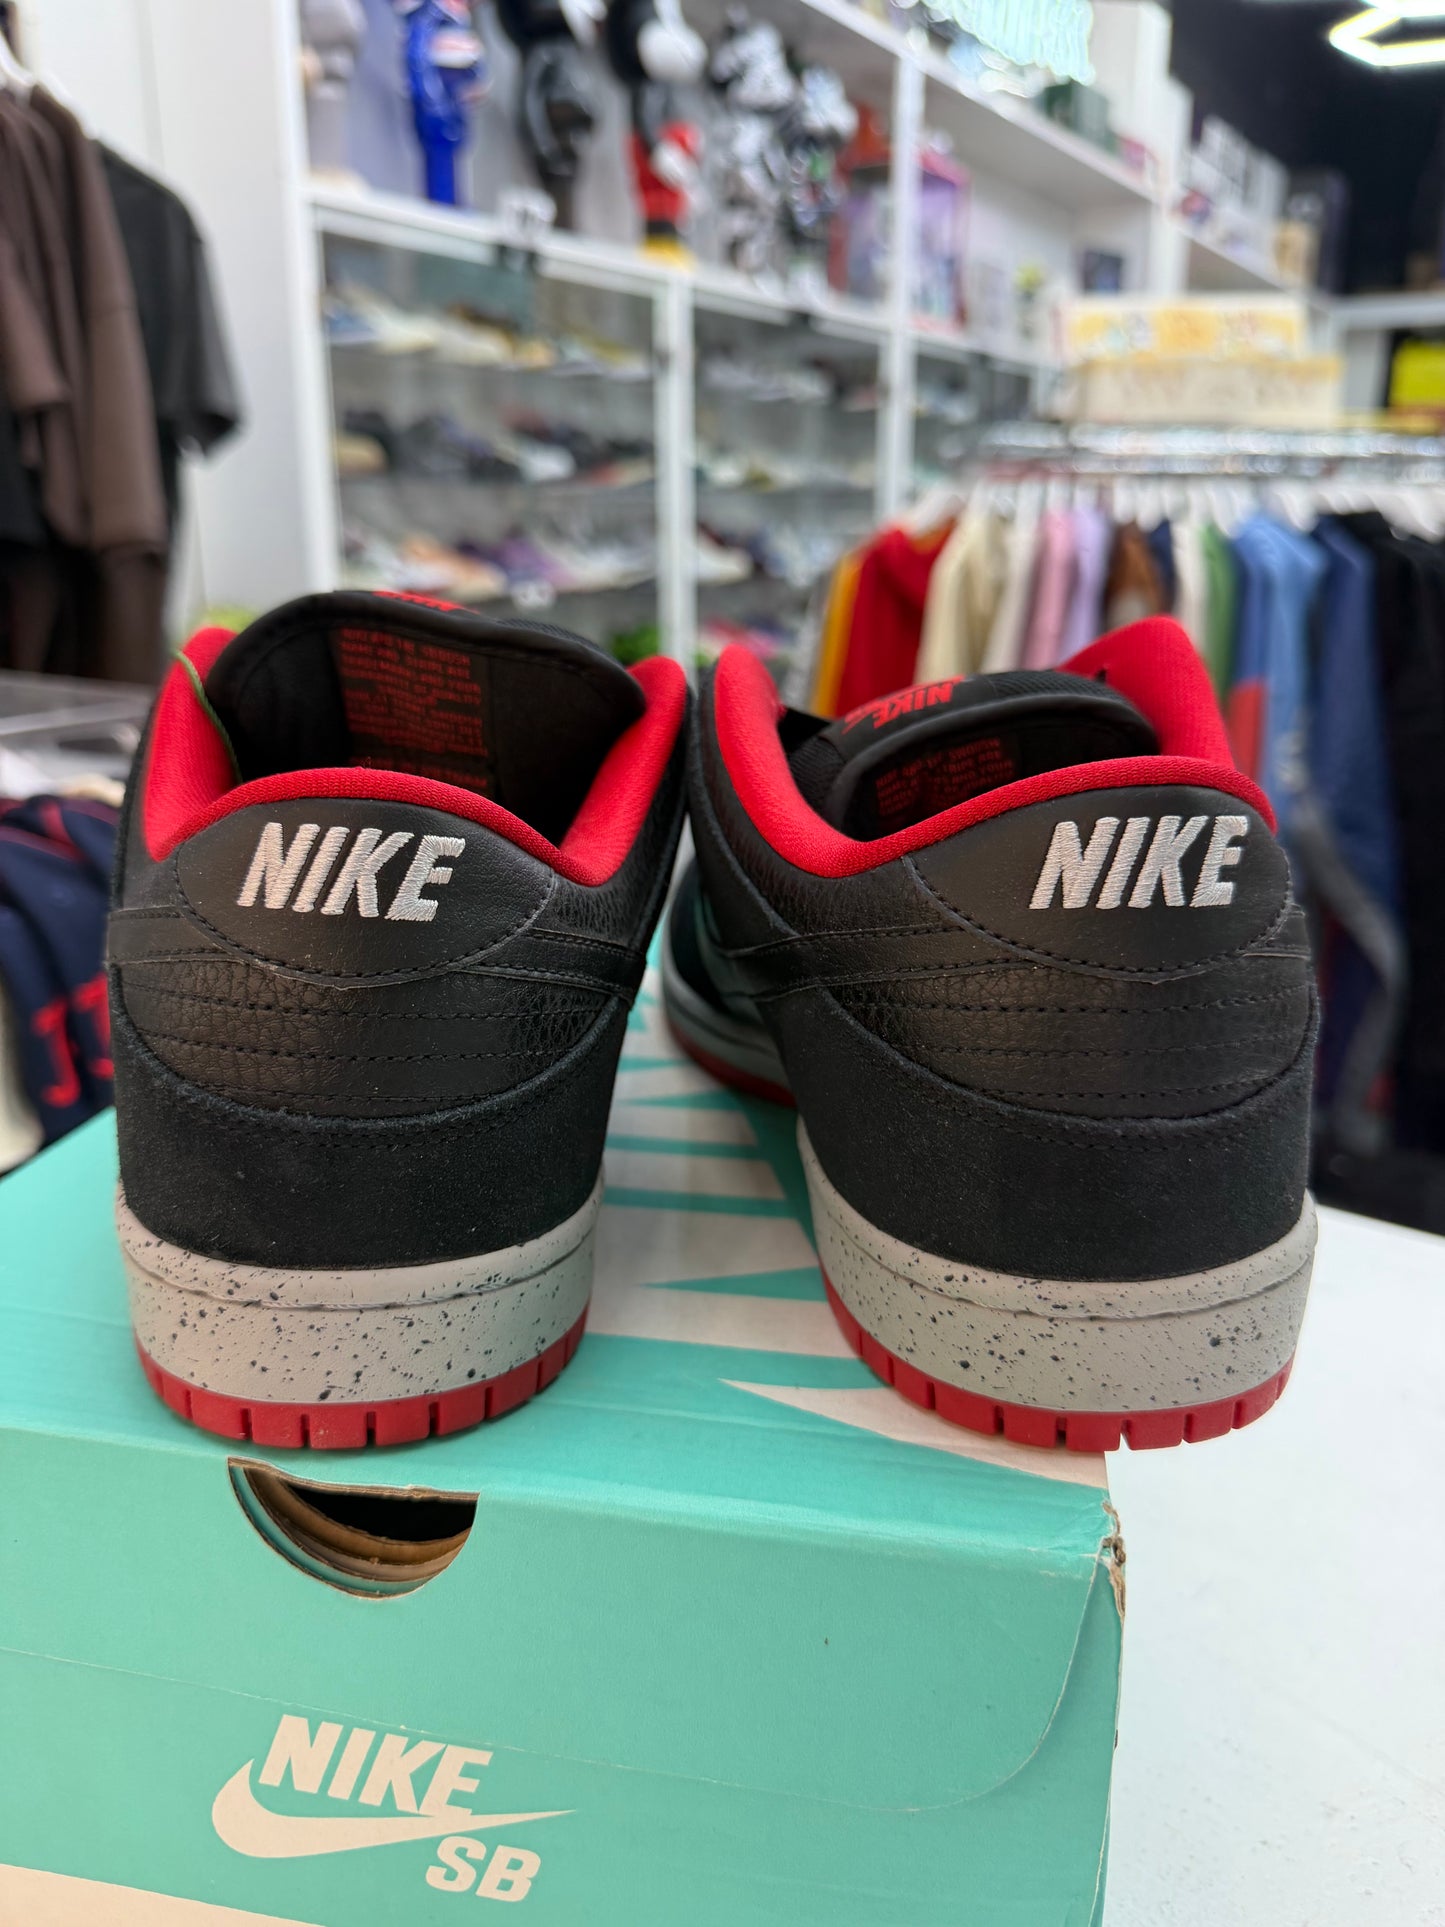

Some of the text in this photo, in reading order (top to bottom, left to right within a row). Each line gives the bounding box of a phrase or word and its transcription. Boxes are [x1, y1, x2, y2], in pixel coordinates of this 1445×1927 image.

[873, 681, 953, 729] NIKE
[237, 822, 466, 922] NIKE
[1029, 816, 1249, 910] NIKE
[259, 1714, 494, 1817] NIKE
[425, 1836, 542, 1902] SB
